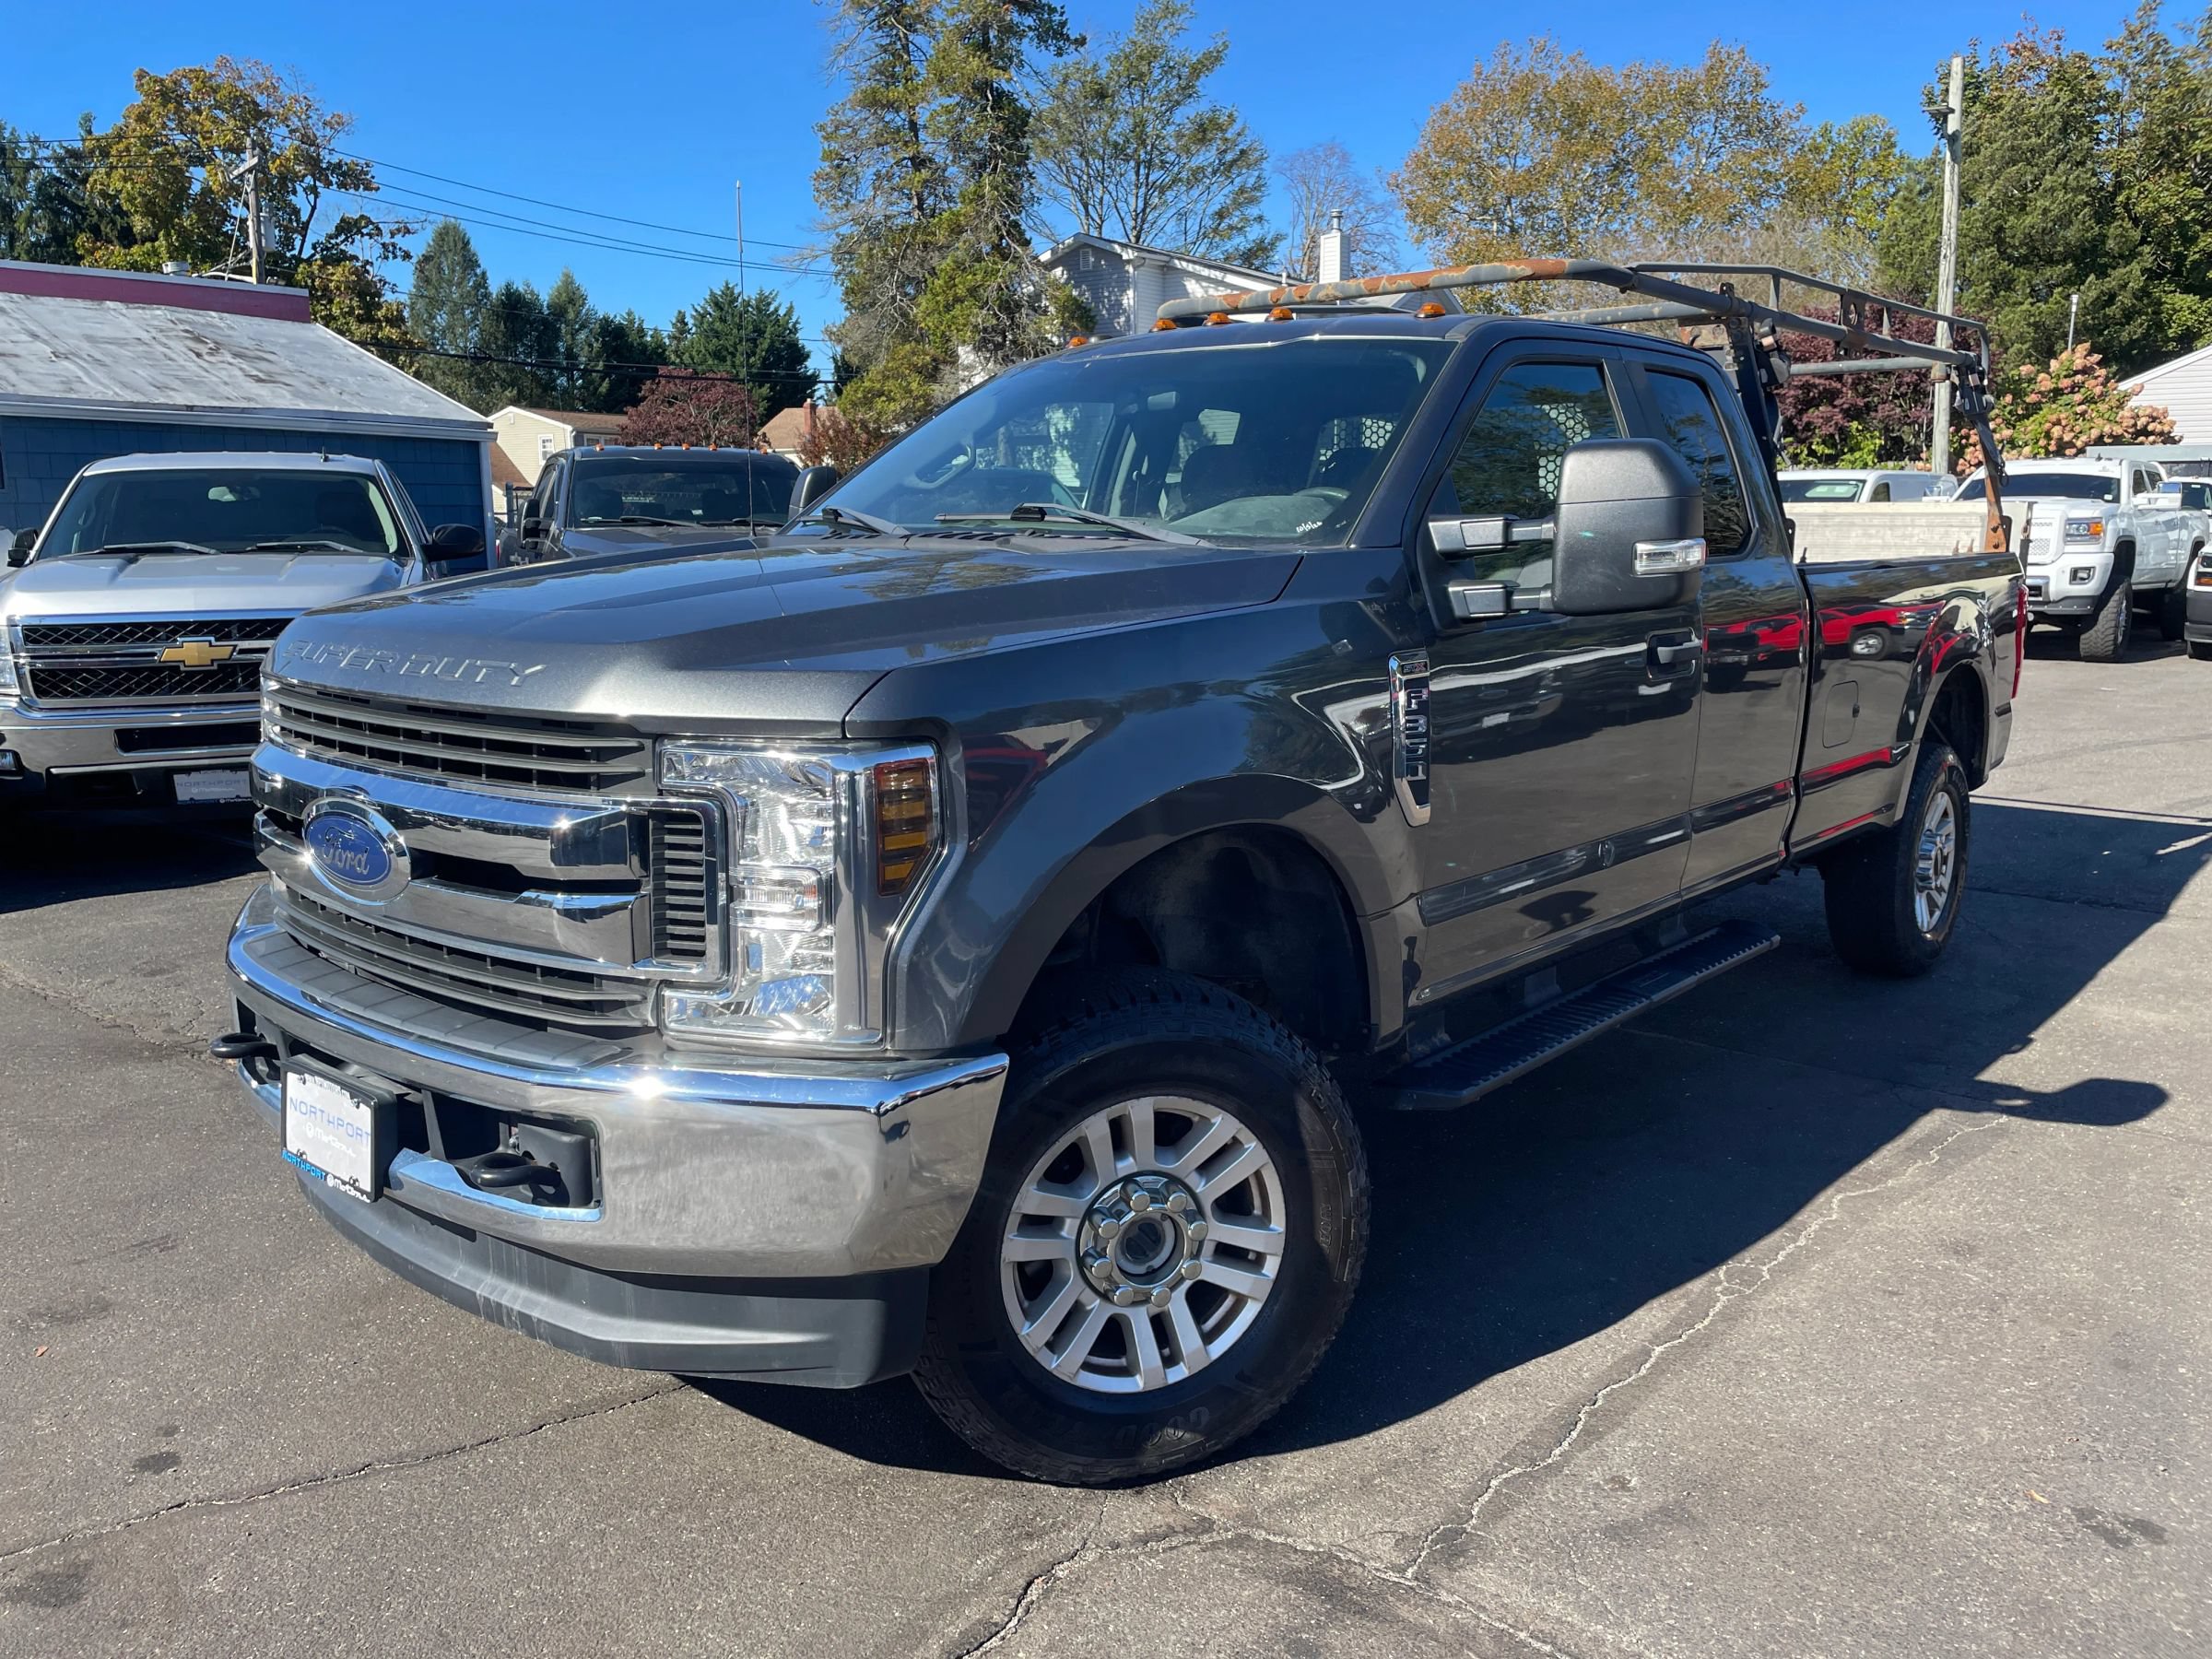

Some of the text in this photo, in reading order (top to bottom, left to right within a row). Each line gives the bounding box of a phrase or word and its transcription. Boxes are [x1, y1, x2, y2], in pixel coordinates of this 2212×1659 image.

[282, 640, 548, 687] SUPER DUTY
[322, 826, 370, 875] Ford
[288, 1096, 371, 1145] NORTHPORT
[282, 1149, 326, 1182] NORTHPORT
